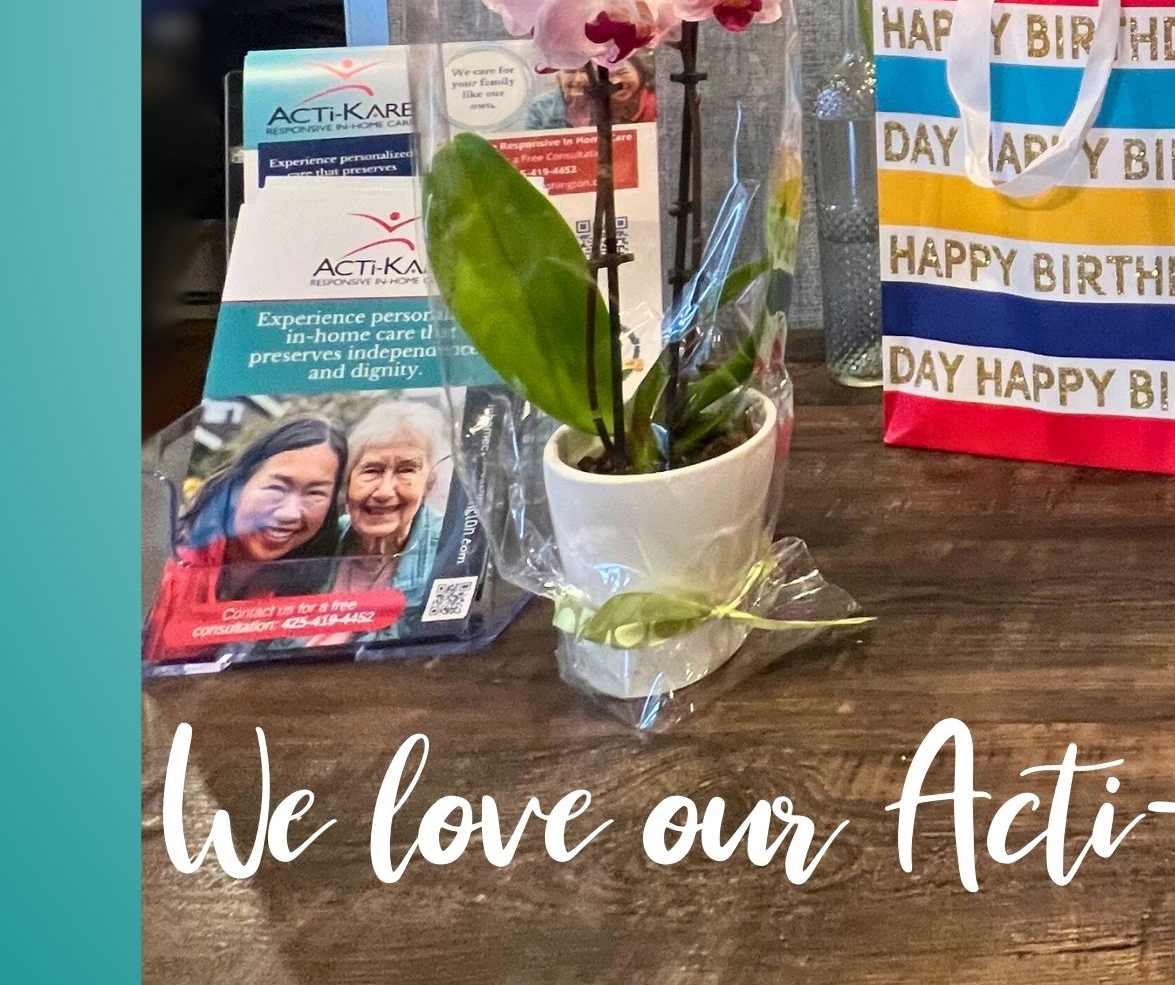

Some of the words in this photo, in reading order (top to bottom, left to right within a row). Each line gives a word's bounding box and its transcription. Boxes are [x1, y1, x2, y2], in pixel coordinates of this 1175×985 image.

[881, 6, 1013, 56] HAPY
[451, 68, 472, 77] We
[473, 68, 496, 76] care
[498, 66, 514, 75] for
[451, 79, 477, 89] your
[480, 77, 515, 88] family
[462, 90, 483, 99] like
[266, 125, 332, 136] RESPONSIVE
[336, 121, 383, 131] IN-HOME
[387, 119, 412, 127] CAR
[576, 135, 598, 145] Hom
[883, 120, 959, 167] DAY
[269, 155, 338, 169] Experience
[546, 149, 598, 161] Consultati
[343, 164, 398, 176] preserves
[312, 257, 428, 277] ACTi-KA
[889, 234, 1017, 287] HAPPY
[310, 277, 372, 287] RESPONSIVE
[375, 277, 419, 286] IN-HOME
[257, 311, 366, 330] Experience
[286, 325, 365, 344] in-home
[369, 329, 410, 341] care
[248, 348, 342, 368] preserves
[308, 364, 344, 380] and
[351, 362, 423, 381] dignity.
[889, 345, 965, 393] DAY
[976, 356, 1116, 407] HAPPY
[222, 606, 276, 621] Contact
[297, 601, 316, 614] for
[331, 599, 358, 612] free
